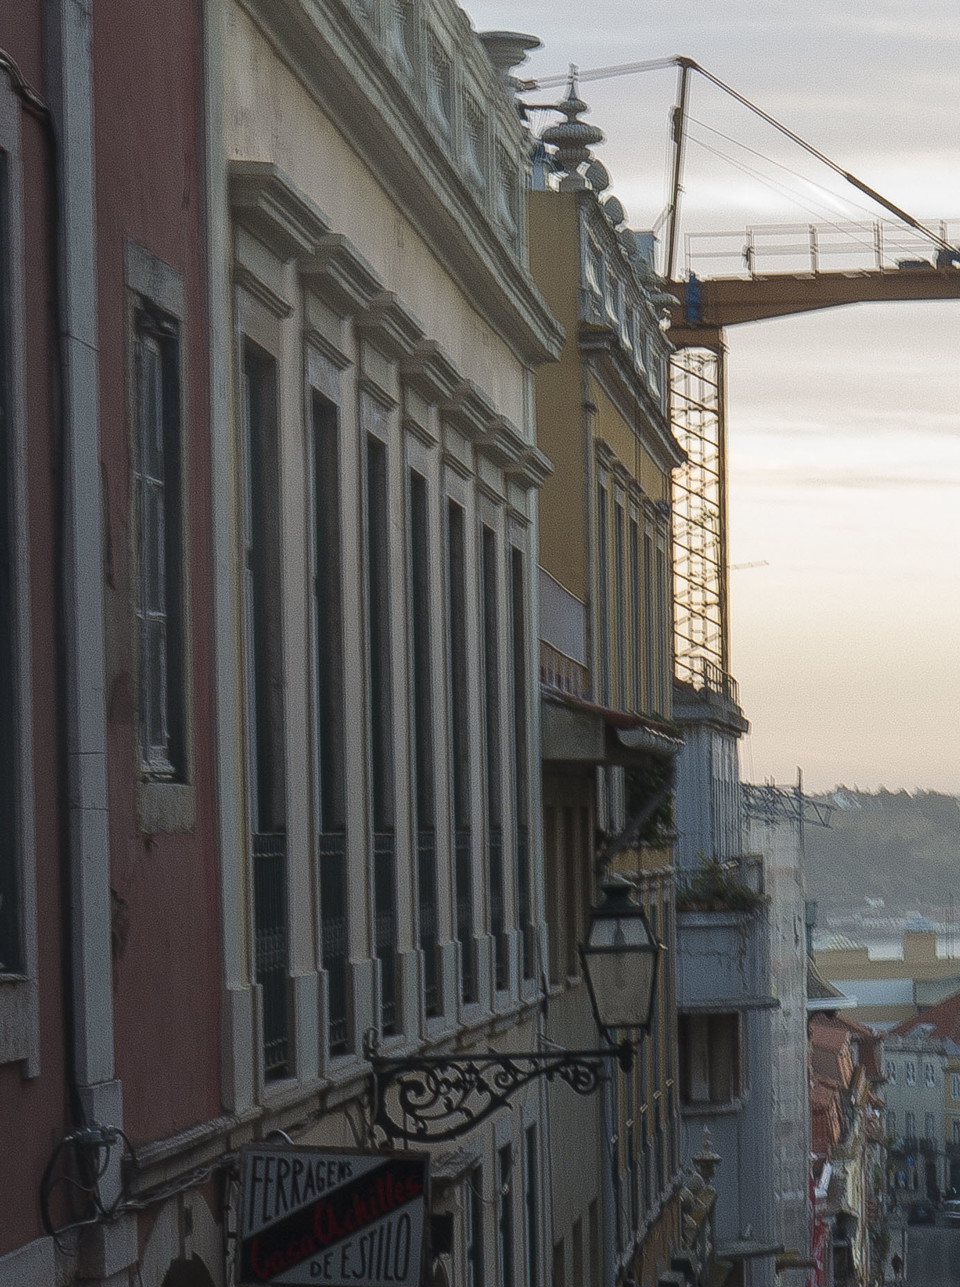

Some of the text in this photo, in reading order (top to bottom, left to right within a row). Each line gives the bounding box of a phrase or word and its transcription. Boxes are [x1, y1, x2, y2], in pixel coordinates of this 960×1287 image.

[250, 1156, 353, 1231] FERRAGENS
[250, 1173, 422, 1280] Casa Achilles
[310, 1213, 411, 1281] DE ESTILO
